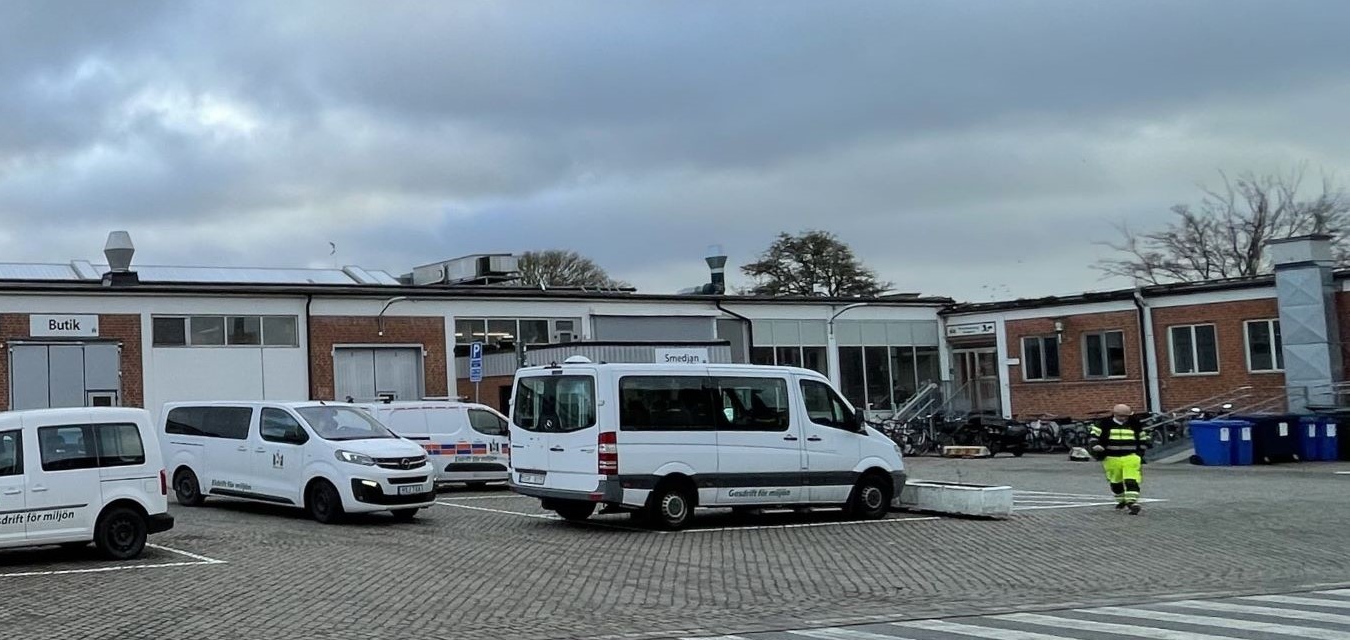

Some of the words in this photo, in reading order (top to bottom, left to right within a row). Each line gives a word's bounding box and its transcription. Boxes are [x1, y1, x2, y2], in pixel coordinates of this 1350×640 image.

[49, 319, 80, 330] Butik
[473, 344, 480, 358] P
[665, 353, 699, 364] Smedjan
[27, 512, 41, 522] för
[43, 510, 75, 522] miljön
